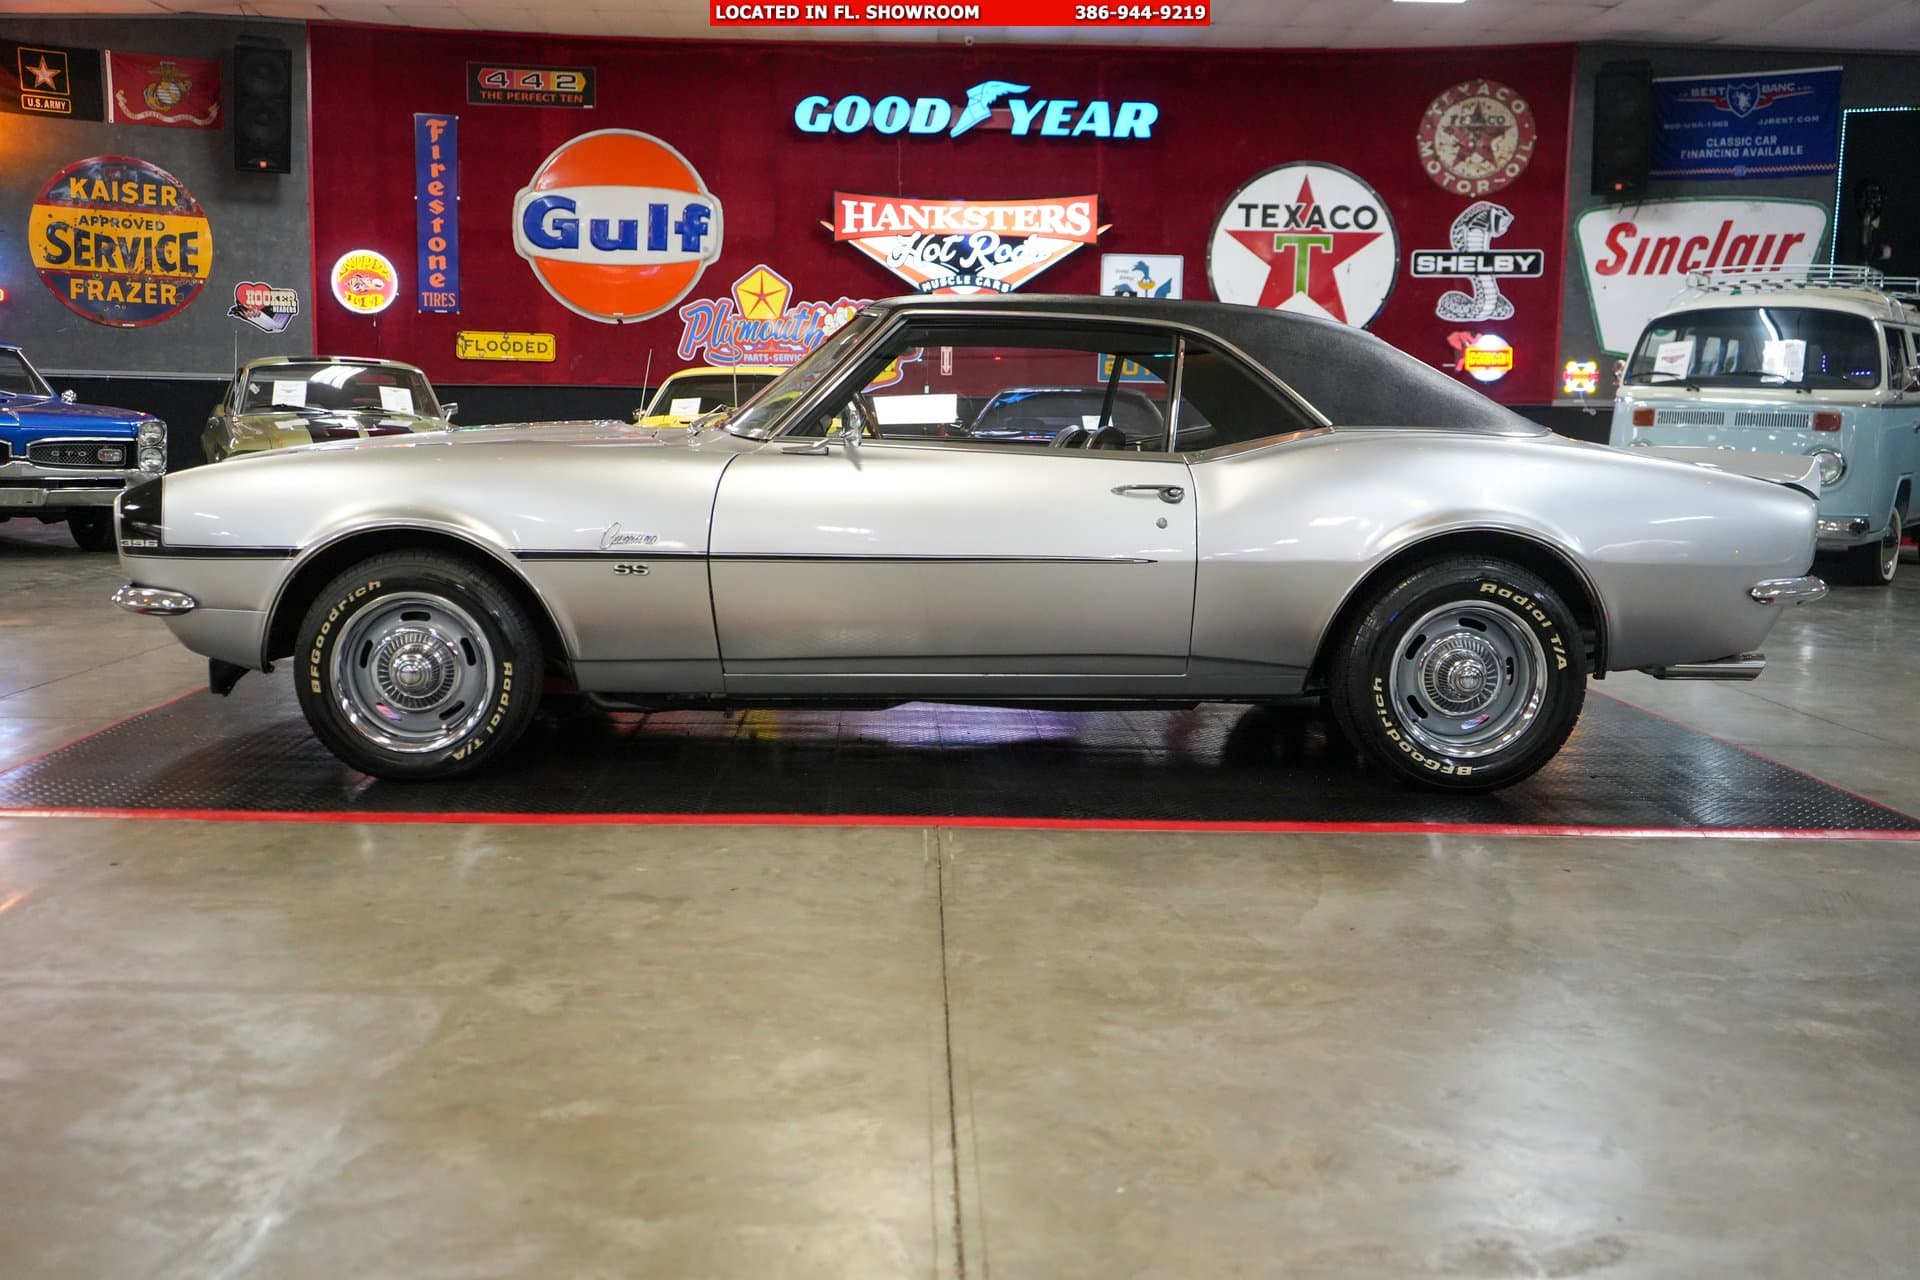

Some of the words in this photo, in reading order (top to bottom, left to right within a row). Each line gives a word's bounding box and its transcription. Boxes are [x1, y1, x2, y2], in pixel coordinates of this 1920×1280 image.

[44, 98, 66, 110] ARMY
[480, 90, 502, 99] THE
[506, 91, 556, 103] PERFECT
[560, 94, 584, 104] TEN
[1691, 87, 1726, 97] BEST
[794, 95, 951, 134] GOOD
[1008, 99, 1159, 138] YEAR
[1680, 149, 1740, 159] FINANCING
[1742, 145, 1803, 157] AVAILABLE
[1706, 137, 1752, 148] CLASSIC
[1755, 135, 1777, 146] CAR
[69, 176, 178, 207] KAISER
[425, 118, 449, 288] Firestone
[78, 215, 166, 232] APPROVED
[523, 195, 711, 253] Gulf
[841, 199, 1091, 236] HANKSTERS
[1237, 202, 1378, 231] TEXACO
[45, 221, 199, 274] SERVICE
[886, 230, 963, 268] Hot
[1595, 218, 1805, 276] Sinclair
[1416, 255, 1536, 274] SHELBY
[69, 278, 177, 305] FRAZER
[922, 276, 971, 292] MUSCLE
[975, 276, 1011, 293] CARS
[422, 292, 456, 307] TIRES
[464, 339, 548, 353] FLOODED
[685, 304, 824, 361] Plymouth
[613, 564, 649, 576] SS
[1480, 582, 1553, 629] Radial
